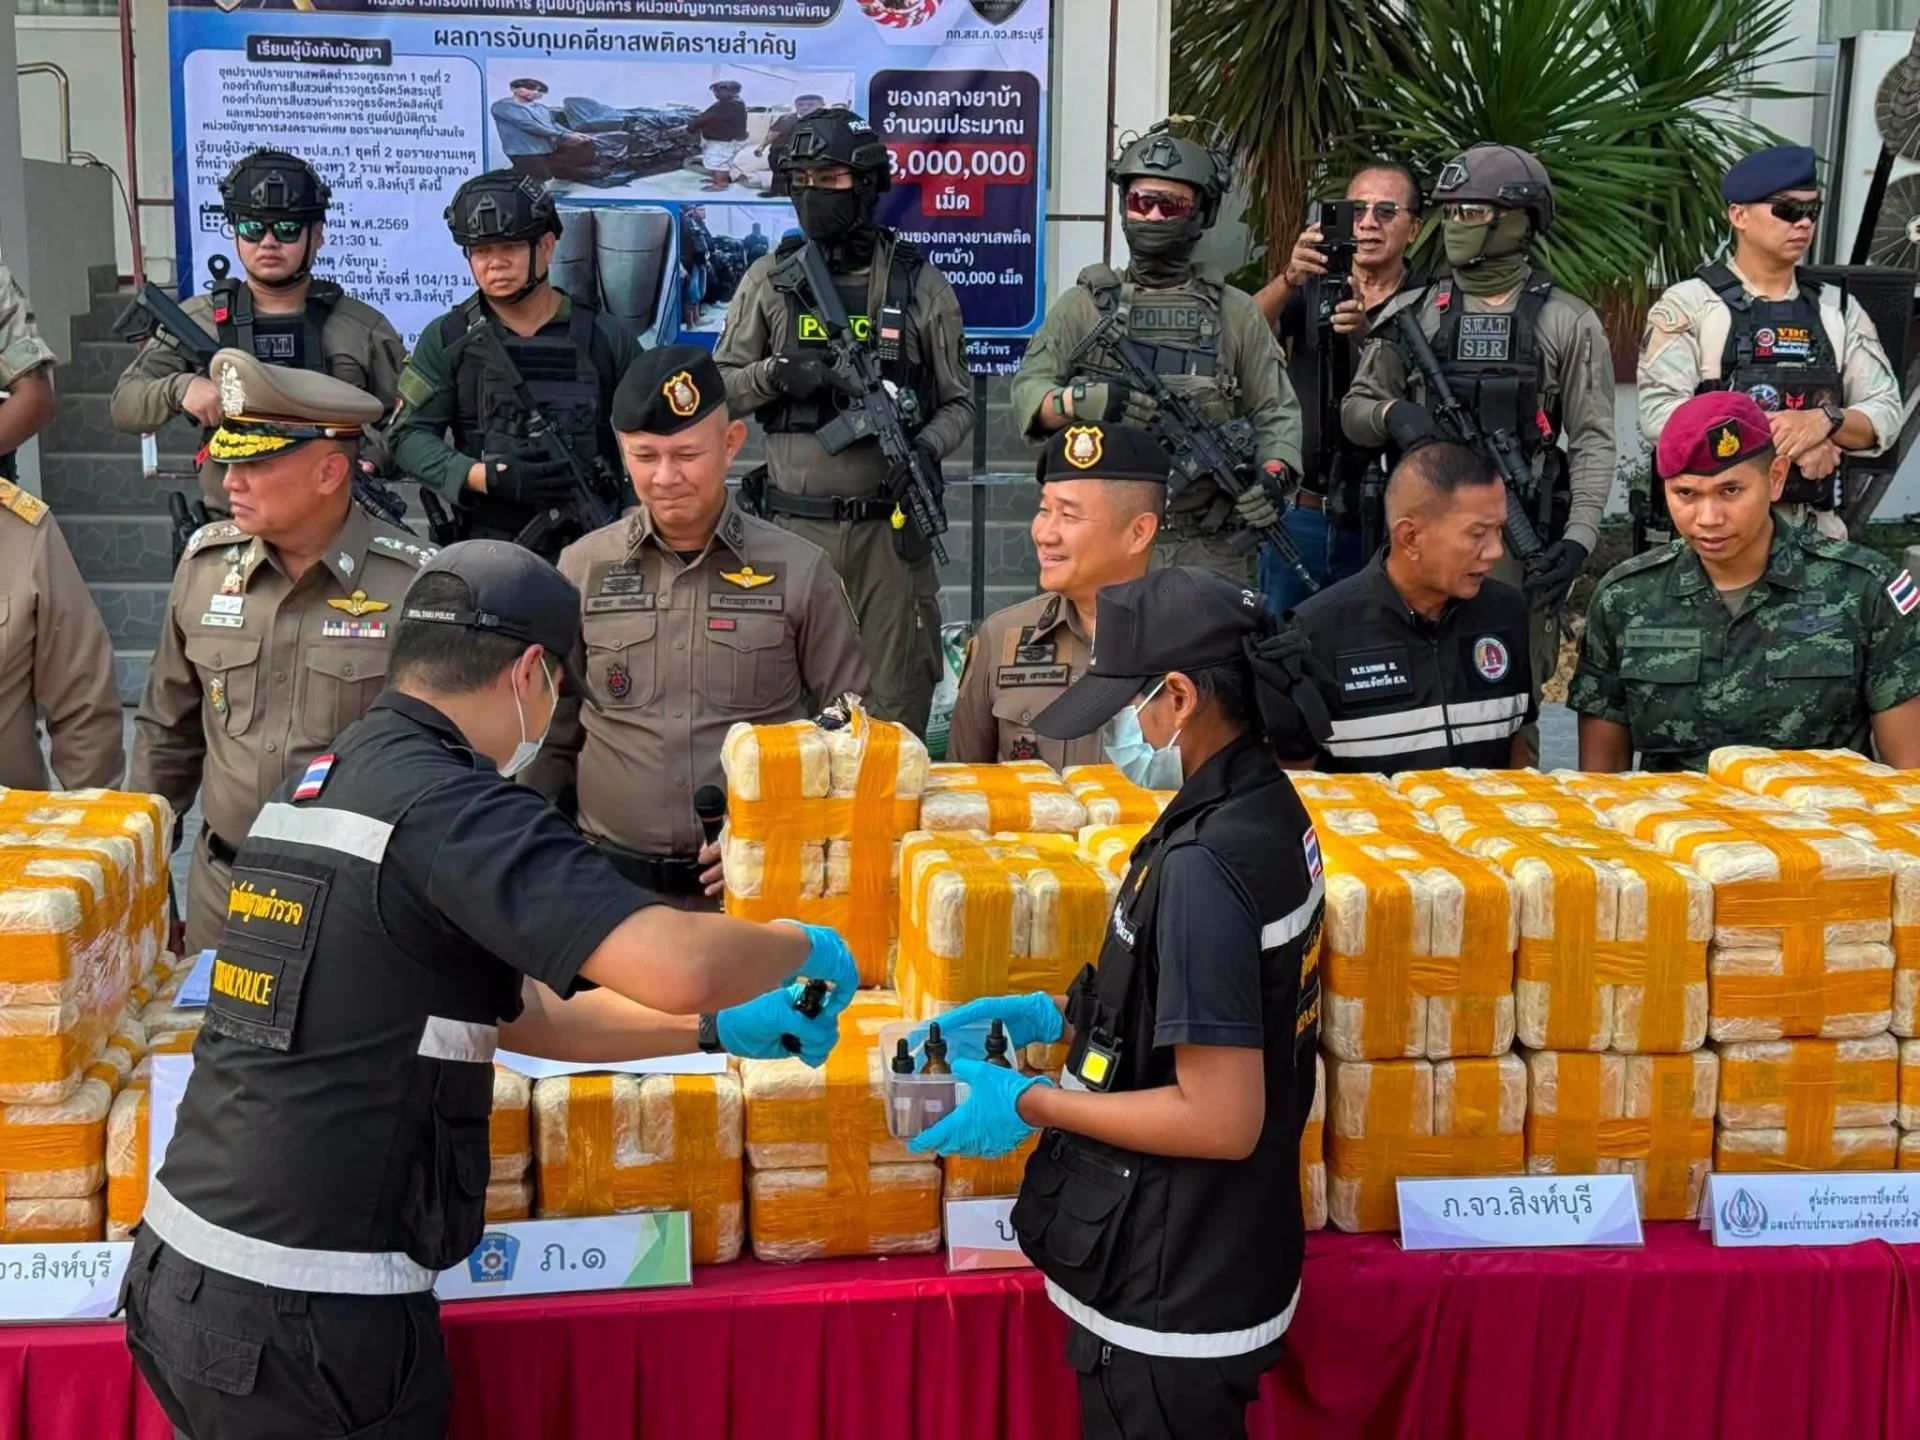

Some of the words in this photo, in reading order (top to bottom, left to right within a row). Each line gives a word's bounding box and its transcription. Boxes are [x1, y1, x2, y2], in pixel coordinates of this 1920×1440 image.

[536, 0, 632, 14] ศูนยปฏบตการ
[636, 0, 831, 17] หนวยบญชาการสงครามพิเศษ
[256, 39, 382, 62] เรียนผู้บังคับบัญชา
[411, 72, 416, 83] 1
[420, 69, 441, 85] ชุดที่
[444, 73, 451, 83] 2
[887, 85, 1022, 107] ของกลางยาบ้า
[883, 112, 1025, 135] จำนวนประมาณ
[356, 142, 381, 160] ชุดที่
[384, 147, 392, 157] 2
[396, 147, 477, 164] ขอรายงานเหตุ
[350, 163, 356, 173] 2
[361, 164, 381, 174] ราย
[385, 159, 469, 176] พร้อมของกลาง
[419, 175, 442, 191] ดังนี้
[935, 187, 970, 210] เม็ด
[351, 218, 409, 230] พ.ศ.2569
[329, 234, 366, 247] 21:30
[370, 236, 382, 247] น.
[929, 247, 974, 267] (ยาบ้า)
[376, 269, 410, 285] ห้องที่
[415, 274, 459, 287] 104/13
[462, 278, 475, 287] ม.
[999, 267, 1023, 285] เม็ด
[1131, 308, 1197, 328] POLICE
[1462, 317, 1507, 334] S.W.A.T.
[1463, 339, 1504, 358] SBR
[233, 966, 274, 1006] POLICE
[1442, 1183, 1593, 1224] ภ.จว.สิงห์บุรี
[540, 1243, 607, 1272] ภ.๑
